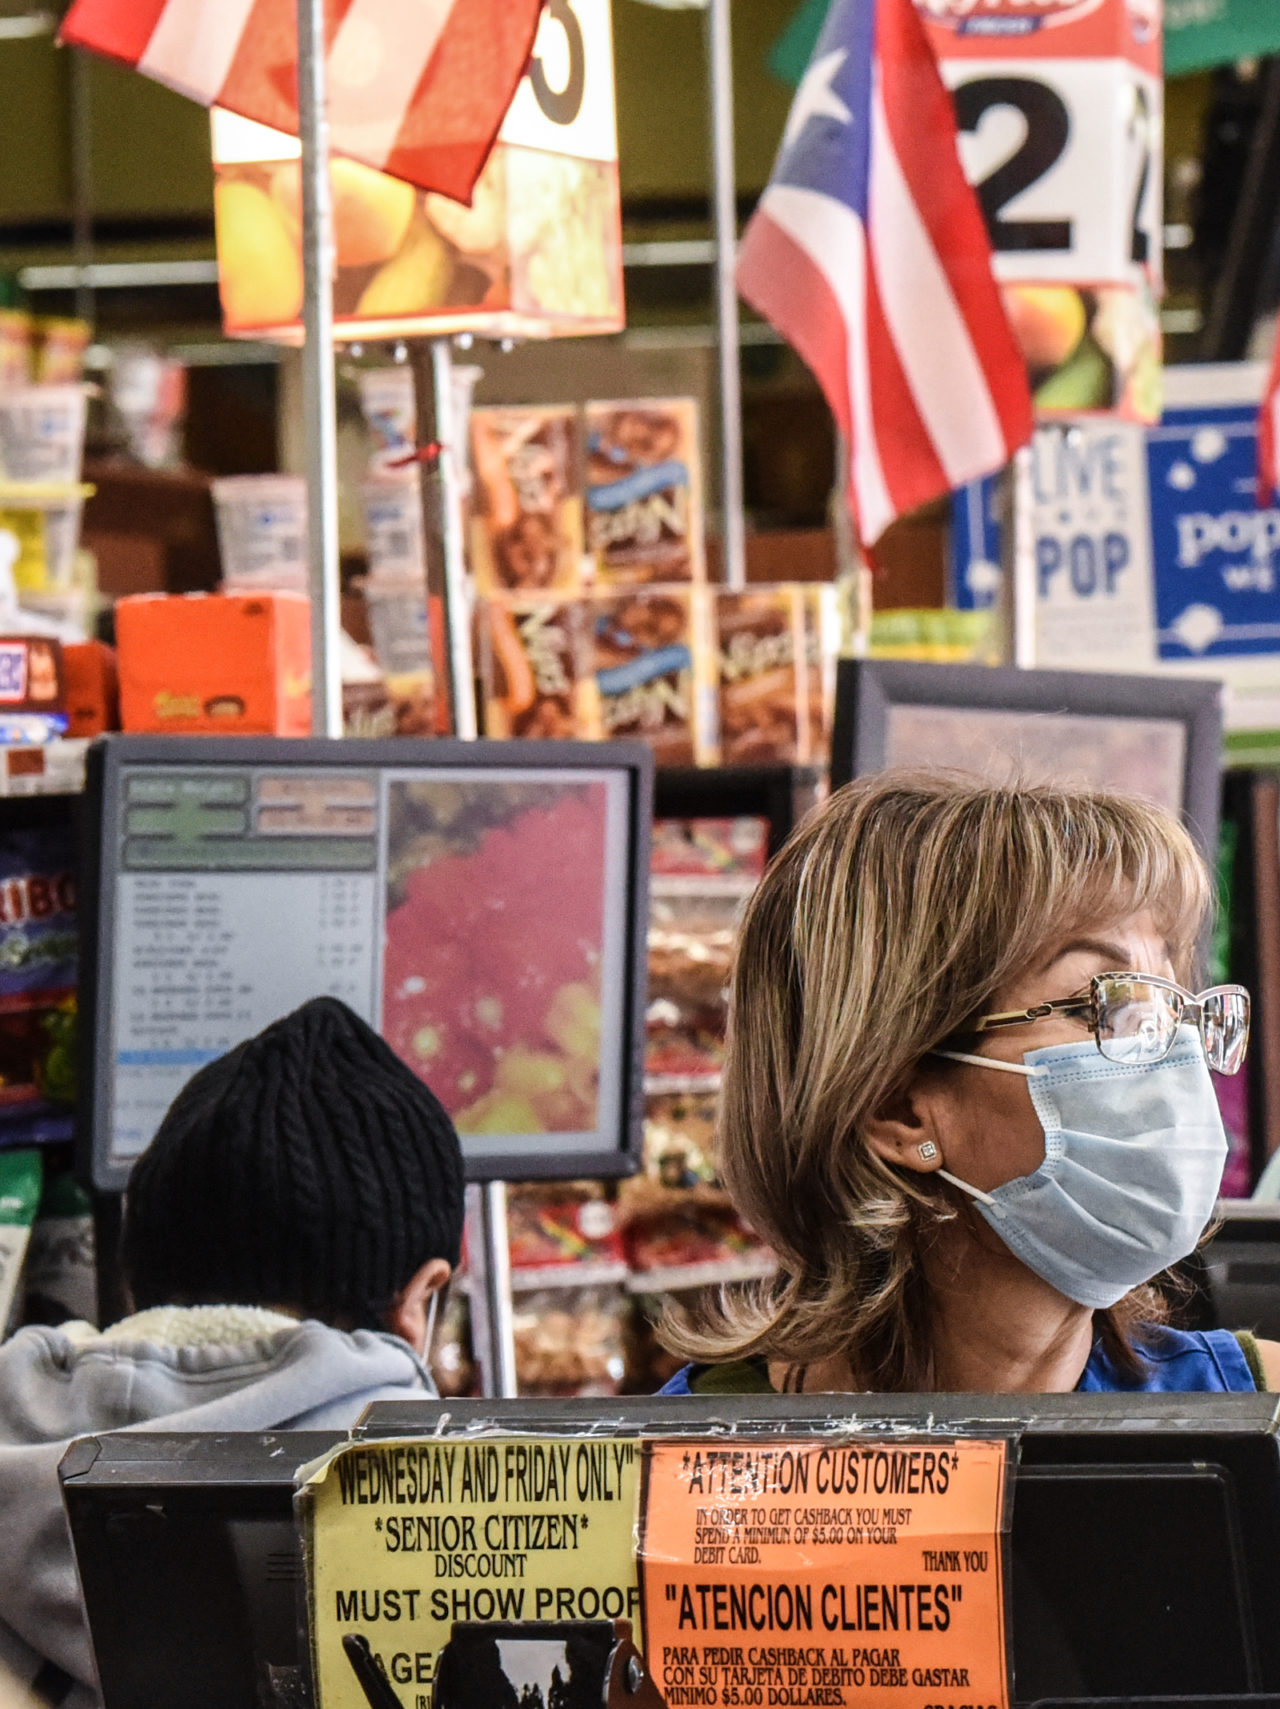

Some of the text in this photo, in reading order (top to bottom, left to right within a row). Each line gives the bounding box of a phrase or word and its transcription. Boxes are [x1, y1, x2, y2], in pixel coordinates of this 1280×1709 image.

[953, 78, 1070, 250] 2
[1037, 533, 1131, 598] POP
[460, 1444, 500, 1504] AND
[505, 1444, 571, 1502] FRIDAY
[576, 1443, 634, 1501] ONLY"
[696, 1508, 912, 1526] IN ORDER TO GET CASHBACK YOU MUST
[695, 1527, 730, 1545] SPEND
[732, 1528, 742, 1545] A
[794, 1527, 811, 1545] OF
[812, 1527, 844, 1545] $5.00
[847, 1528, 863, 1545] ON
[866, 1528, 898, 1545] YOUR
[694, 1546, 762, 1564] DEBIT CARD.
[922, 1551, 988, 1571] THANK YOU
[435, 1553, 528, 1578] DISCOUNT
[335, 1586, 640, 1622] MUST SHOW PROOF
[665, 1584, 962, 1631] "ATENCION CLIENTES"
[663, 1647, 901, 1667] PARA PEDIR CASHBACK AL PAGAR
[663, 1667, 970, 1687] CON SU TARJETA DE DEBITO DEBE GASTAR
[664, 1687, 847, 1707] MINIMO $5.00 DOLLARES.
